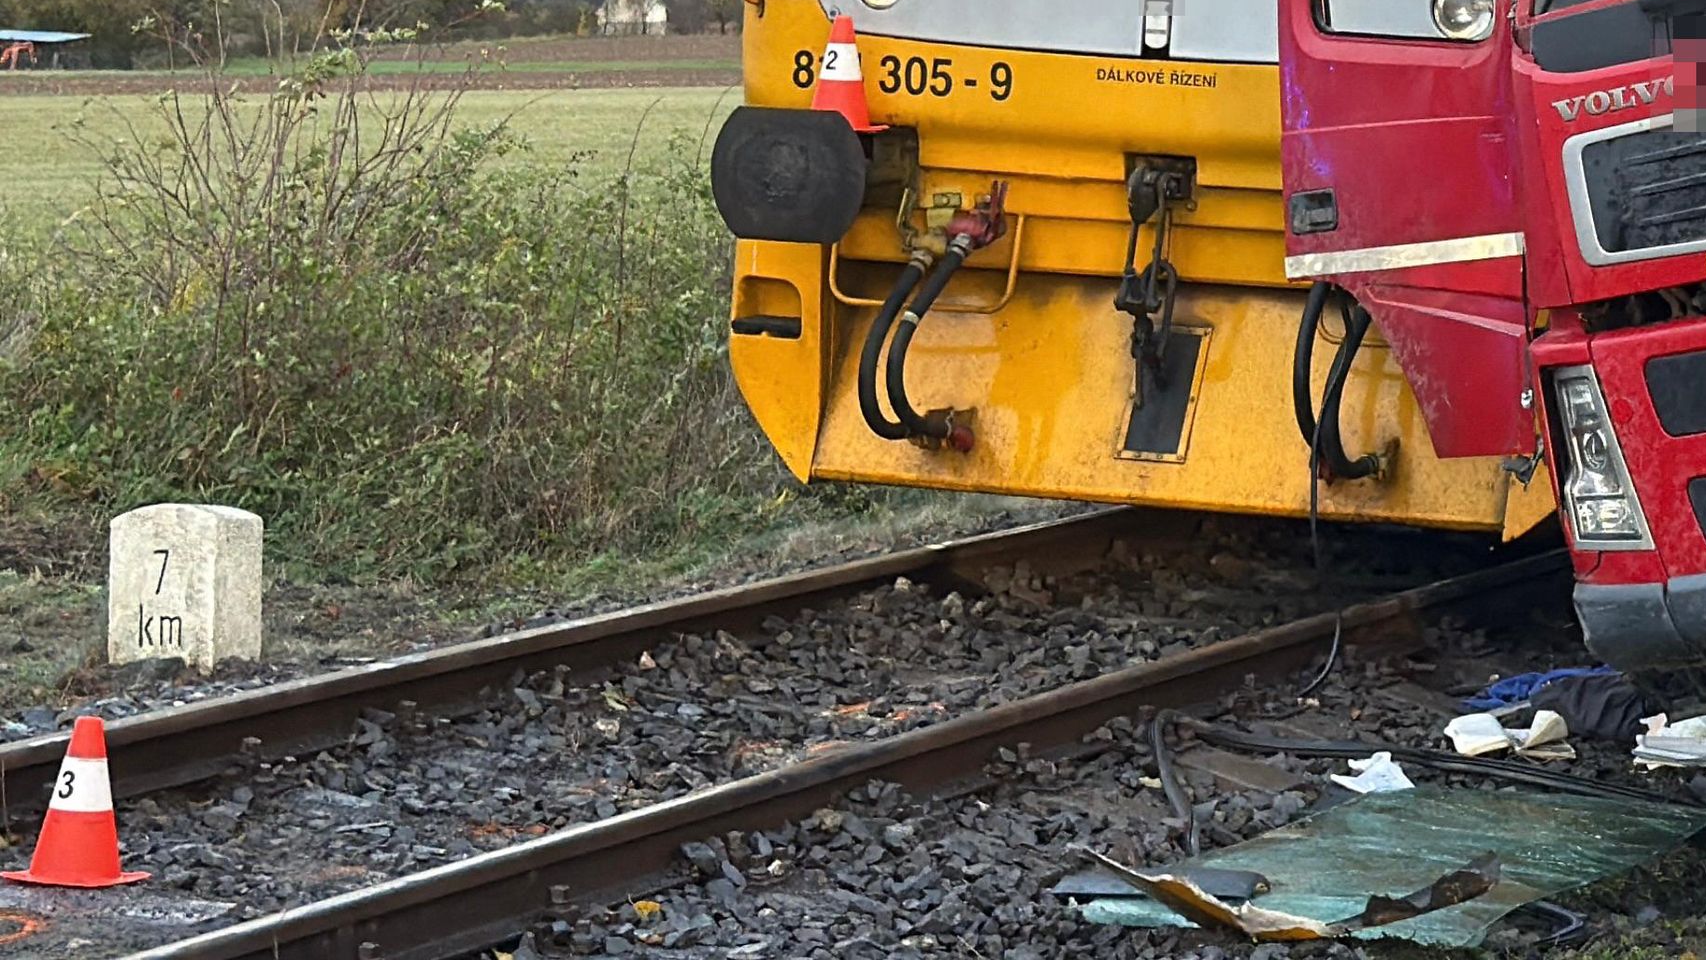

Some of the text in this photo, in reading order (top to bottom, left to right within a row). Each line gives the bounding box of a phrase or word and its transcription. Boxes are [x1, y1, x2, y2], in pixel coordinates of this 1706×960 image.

[825, 50, 838, 70] 2
[879, 55, 953, 97] 305
[1096, 66, 1217, 88] DÁLKOVÉ ŘÍZENÍ
[153, 549, 169, 595] 7
[138, 603, 183, 648] km
[58, 770, 76, 799] 3
